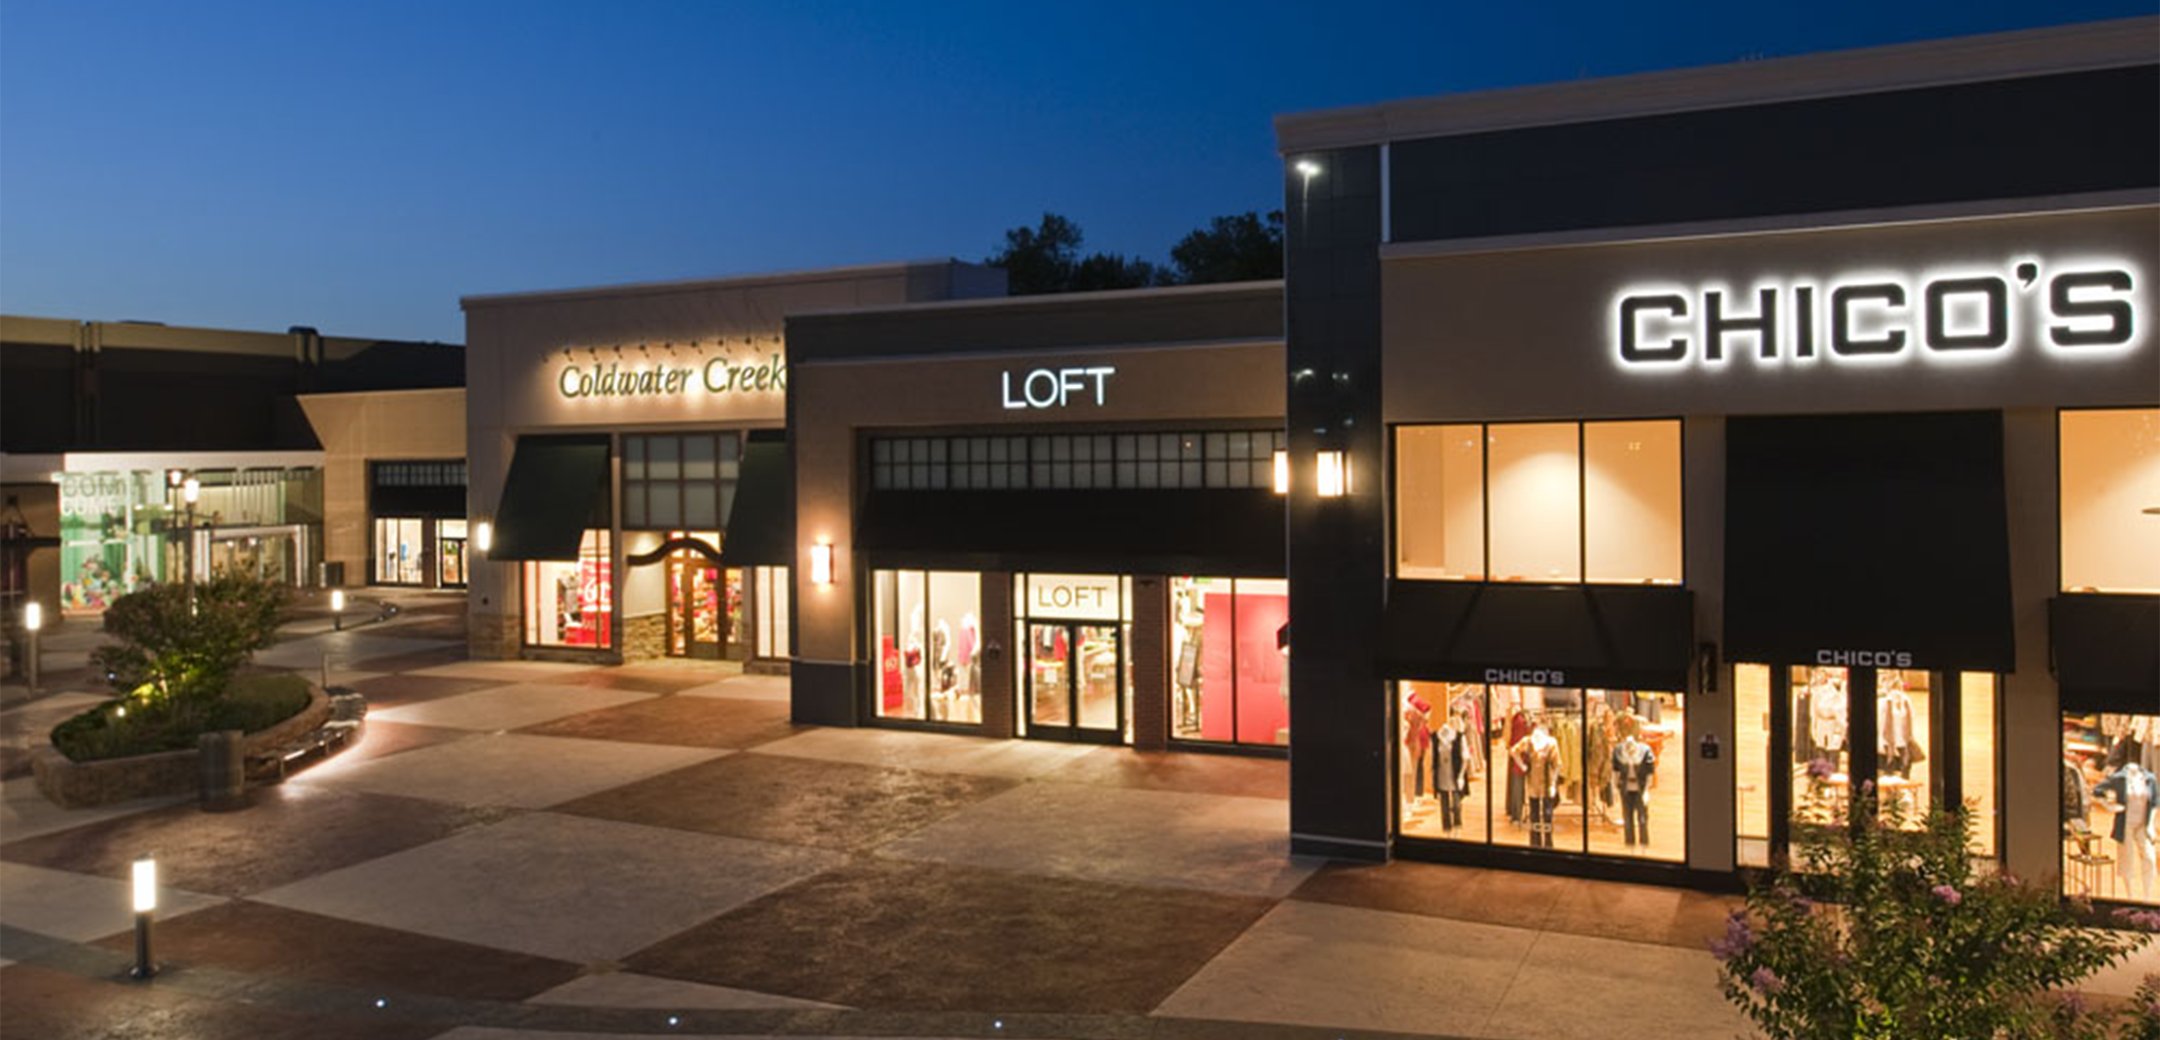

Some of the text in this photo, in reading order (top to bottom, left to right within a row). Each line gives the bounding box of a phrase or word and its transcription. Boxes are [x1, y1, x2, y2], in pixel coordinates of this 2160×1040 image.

[1619, 262, 2133, 362] CHICO'S
[559, 353, 787, 398] Coldwater Creek
[1002, 366, 1115, 408] LOFT
[1038, 585, 1107, 608] LOFT
[1817, 649, 1912, 667] CHICO'S
[1485, 668, 1564, 685] CHICO'S
